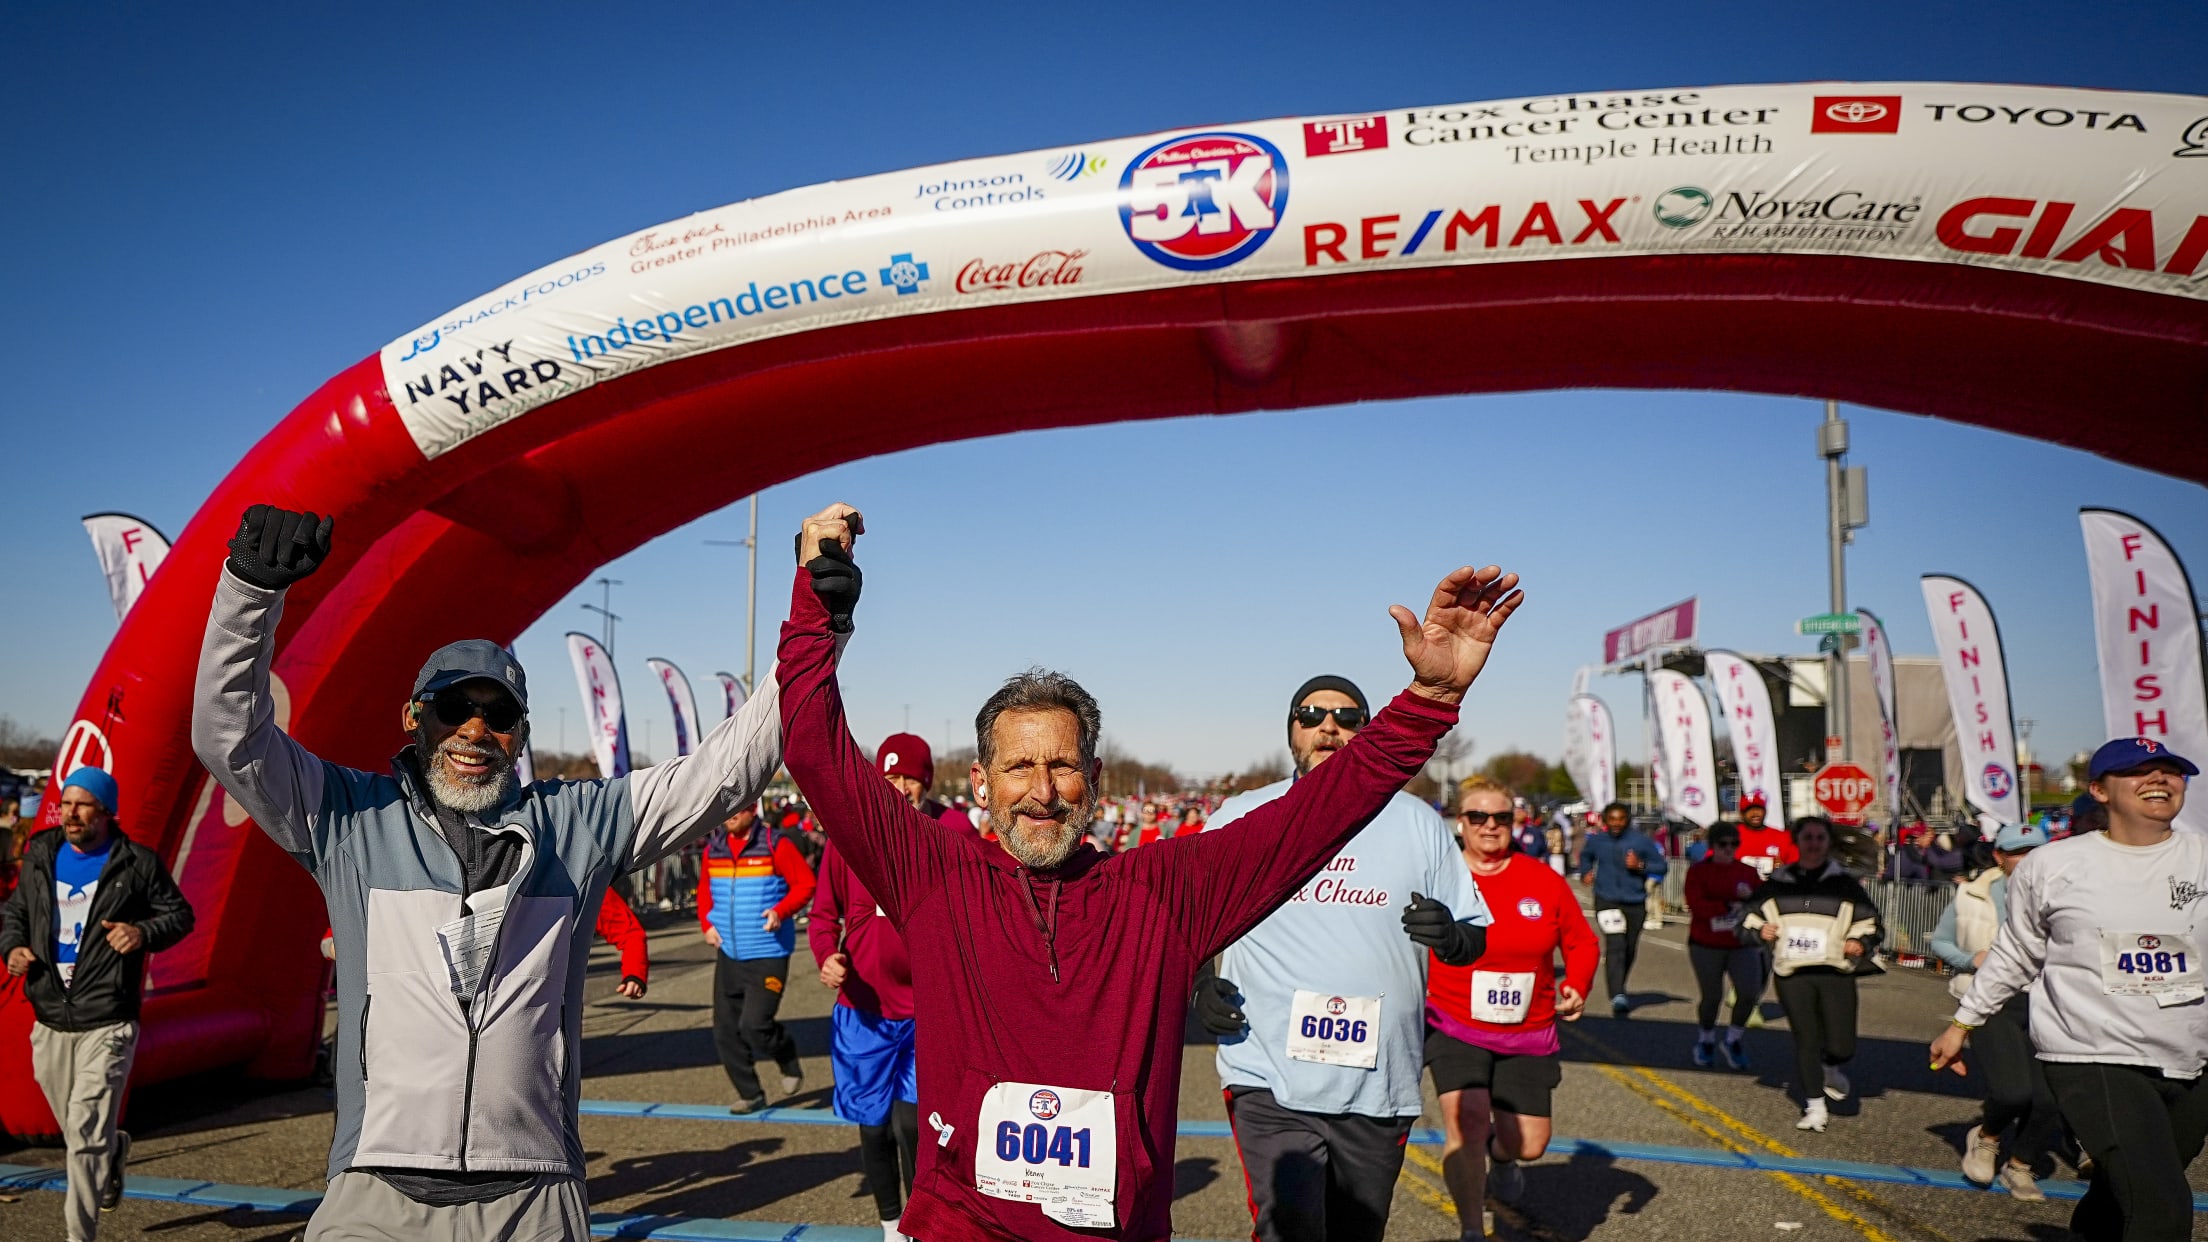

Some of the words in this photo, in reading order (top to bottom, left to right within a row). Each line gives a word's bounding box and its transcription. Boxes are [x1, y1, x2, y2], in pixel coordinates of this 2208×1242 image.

[1404, 116, 1580, 146] Cancer
[1598, 103, 1779, 130] Center
[1406, 105, 1503, 126] Fox
[1522, 92, 1702, 115] Chase
[1924, 103, 2148, 133] TOYOTA
[1506, 134, 1638, 165] Temple
[1650, 134, 1774, 157] Health
[915, 174, 1024, 199] Johnson
[934, 185, 1046, 213] Controls
[1130, 154, 1276, 242] 5K
[1714, 191, 1921, 223] NovaCare
[631, 245, 704, 274] Greater
[712, 215, 837, 250] Philadelphia
[843, 205, 893, 224] Area
[1304, 198, 1628, 267] RE/MAX
[1935, 196, 2208, 277] GIA
[443, 296, 518, 334] SNACK
[513, 262, 606, 301] FOODS
[566, 268, 867, 363] Independence
[405, 339, 513, 404] NAVY
[446, 359, 561, 414] YARD
[2120, 533, 2168, 736] FINISH
[1949, 591, 1996, 752] FINISH
[1672, 679, 1697, 778] FINISH
[1729, 664, 1764, 780] FINISH
[1816, 777, 1873, 801] STOP
[1314, 878, 1388, 907] Chase
[2117, 951, 2187, 975] 4981
[1487, 989, 1522, 1006] 888
[1301, 1014, 1368, 1043] 6036
[996, 1120, 1091, 1169] 6041
